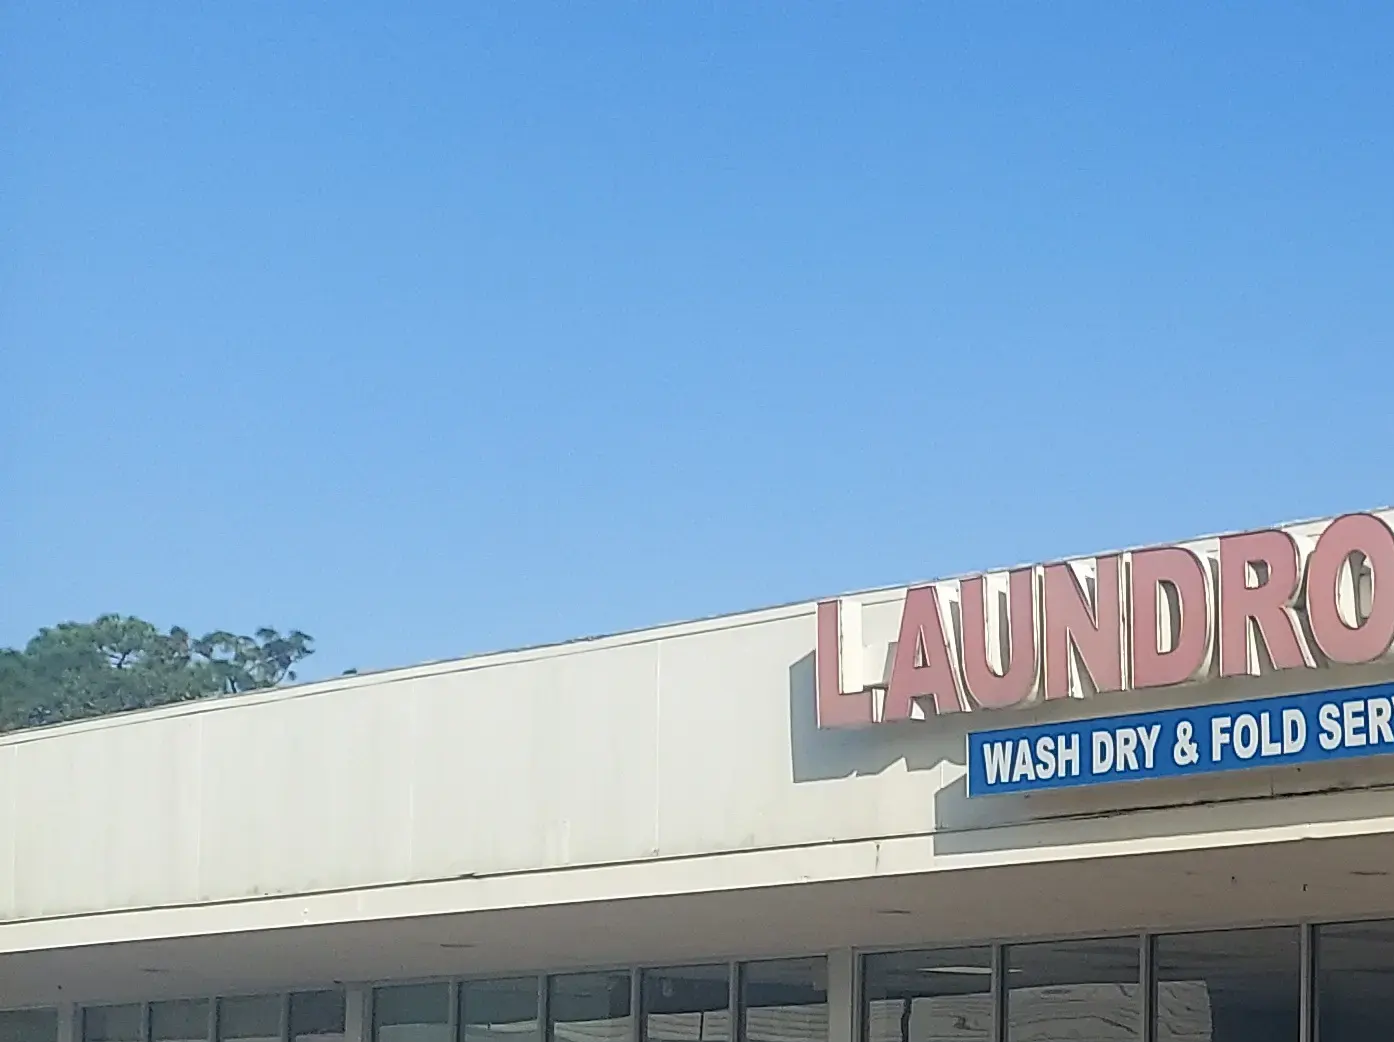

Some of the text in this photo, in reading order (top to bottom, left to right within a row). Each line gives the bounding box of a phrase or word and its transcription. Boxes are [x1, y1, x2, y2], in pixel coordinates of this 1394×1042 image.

[983, 733, 1079, 785] WASH
[1092, 725, 1161, 773] DRY
[1173, 721, 1199, 766] &
[1212, 709, 1306, 762] FOLD
